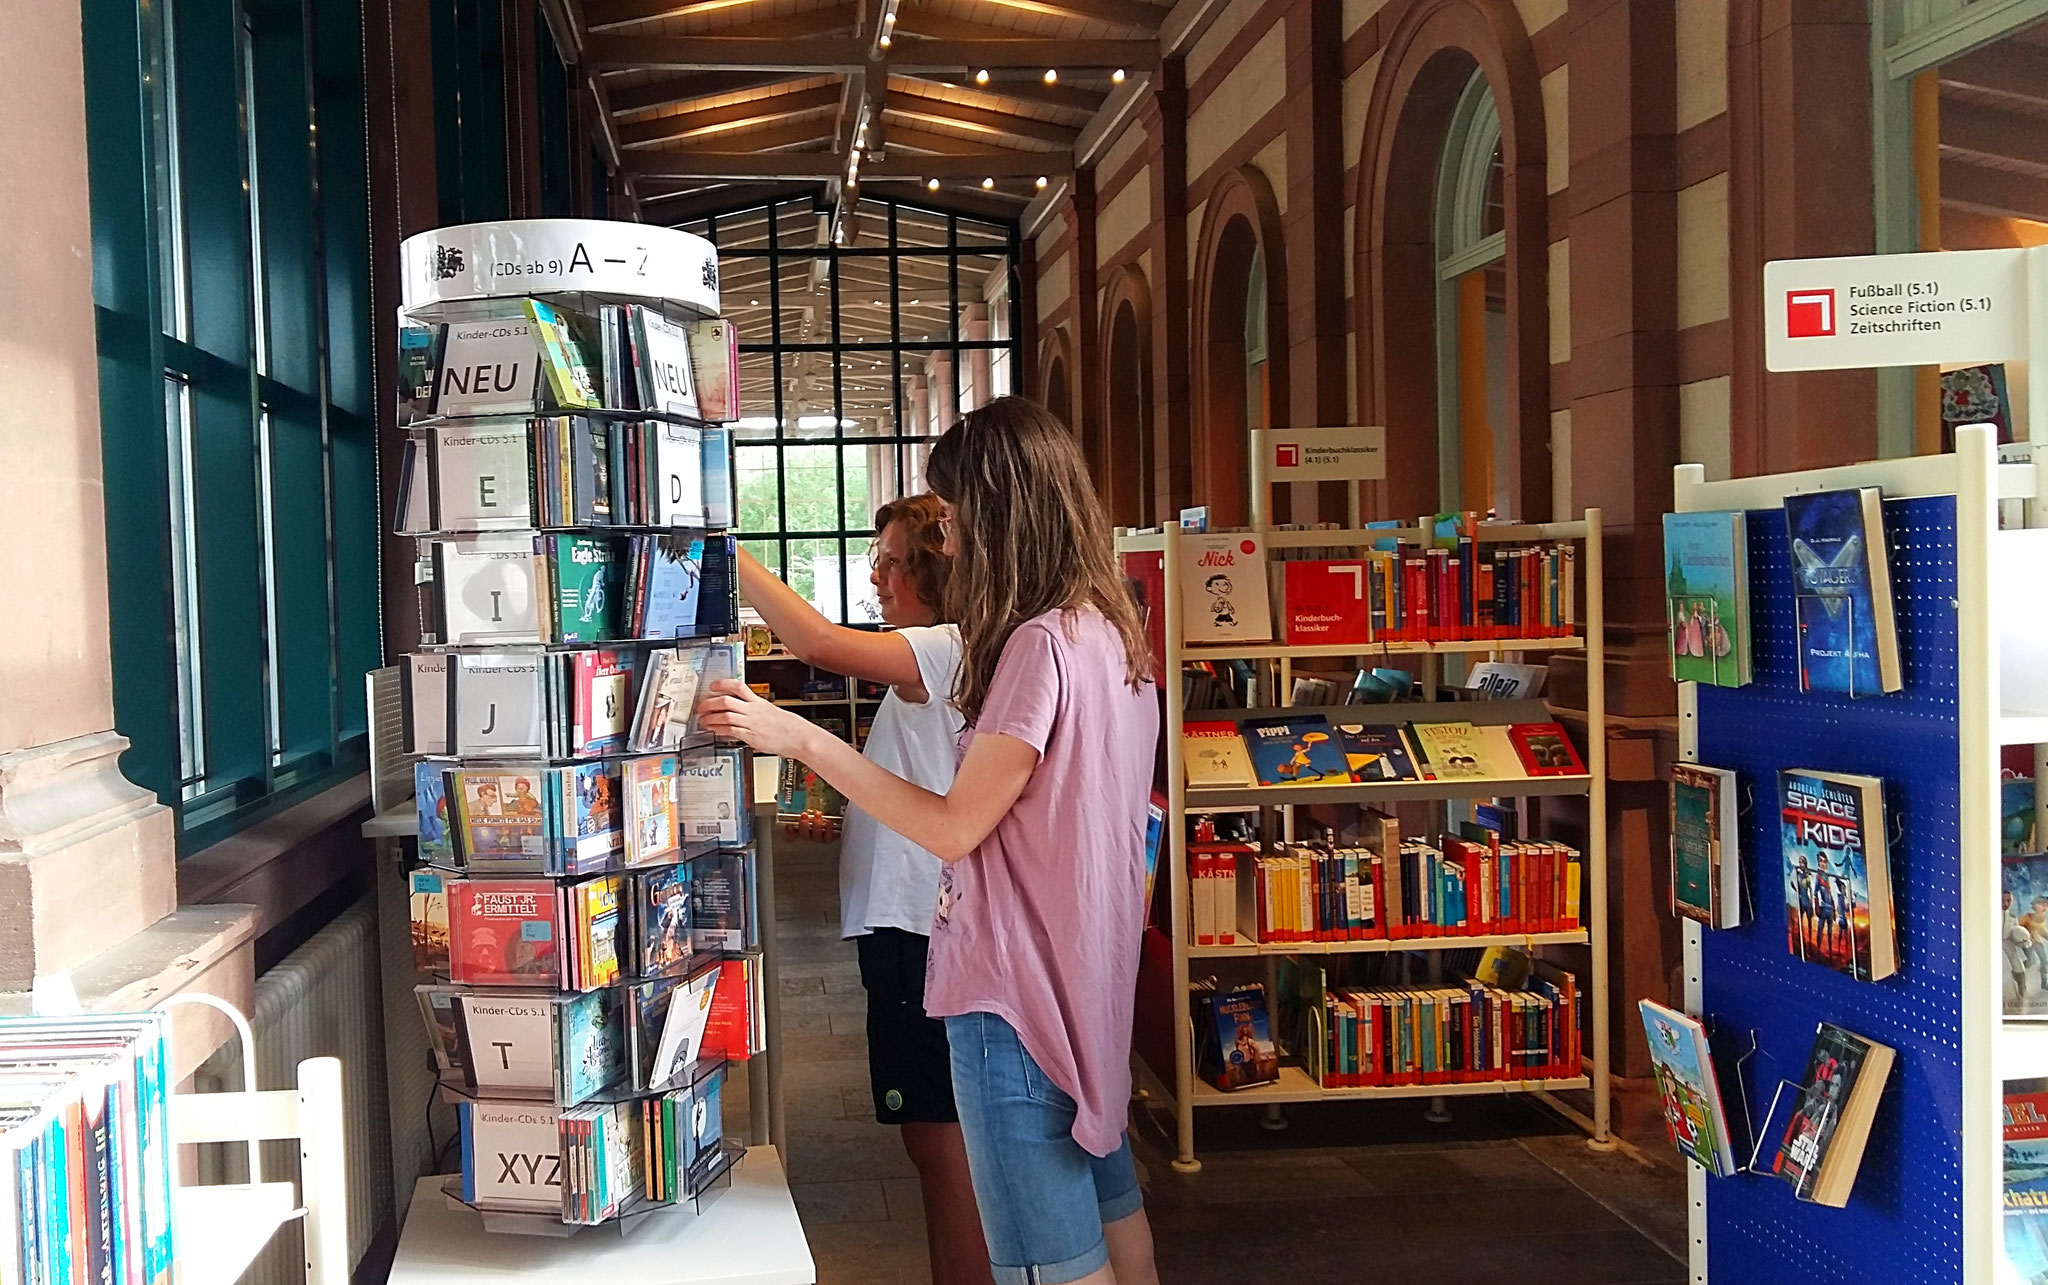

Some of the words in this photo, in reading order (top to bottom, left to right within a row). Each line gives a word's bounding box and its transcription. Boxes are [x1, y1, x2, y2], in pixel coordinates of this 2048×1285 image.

[490, 260, 522, 277] (CDs
[527, 261, 544, 274] ab
[548, 259, 564, 277] 9)
[569, 242, 594, 273] A
[1850, 283, 1903, 298] Fußball
[1907, 281, 1938, 297] (5.1)
[1850, 303, 1903, 316] Science
[1908, 300, 1955, 314] Fiction
[1960, 297, 1992, 312] (5.1)
[456, 328, 512, 340] Kinder-CDs
[514, 326, 529, 336] 5.1
[1850, 319, 1941, 334] Zeitschriften
[443, 363, 519, 396] NEU
[655, 359, 688, 397] NEU
[443, 436, 501, 447] Kinder-CDs
[503, 435, 518, 444] 5.1
[1304, 446, 1378, 454] Kinderbuchklassiker
[1304, 456, 1321, 464] (4.1)
[1323, 456, 1340, 464] (5.1)
[479, 476, 497, 507] E
[671, 474, 682, 503] D
[571, 546, 593, 565] Eagle
[1198, 550, 1235, 567] Nick
[490, 591, 502, 622] I
[1295, 613, 1343, 623] Kinderbuch-
[1295, 624, 1330, 632] klassiker
[1810, 649, 1842, 658] PROJEKT
[1844, 649, 1871, 659] APHA
[481, 703, 496, 735] J
[1788, 781, 1817, 796] ANDREAS
[1787, 790, 1857, 820] SPACE
[1803, 820, 1861, 847] KIDS
[484, 895, 518, 904] FAUST
[520, 895, 536, 904] JR.
[484, 905, 538, 913] ERMITTELT
[472, 1005, 529, 1017] Kinder-CDs
[531, 1007, 546, 1017] 5.1
[492, 1042, 513, 1070] T
[480, 1113, 538, 1125] Kinder-CDs
[540, 1115, 555, 1125] 5.1
[497, 1153, 561, 1186] XYZ
